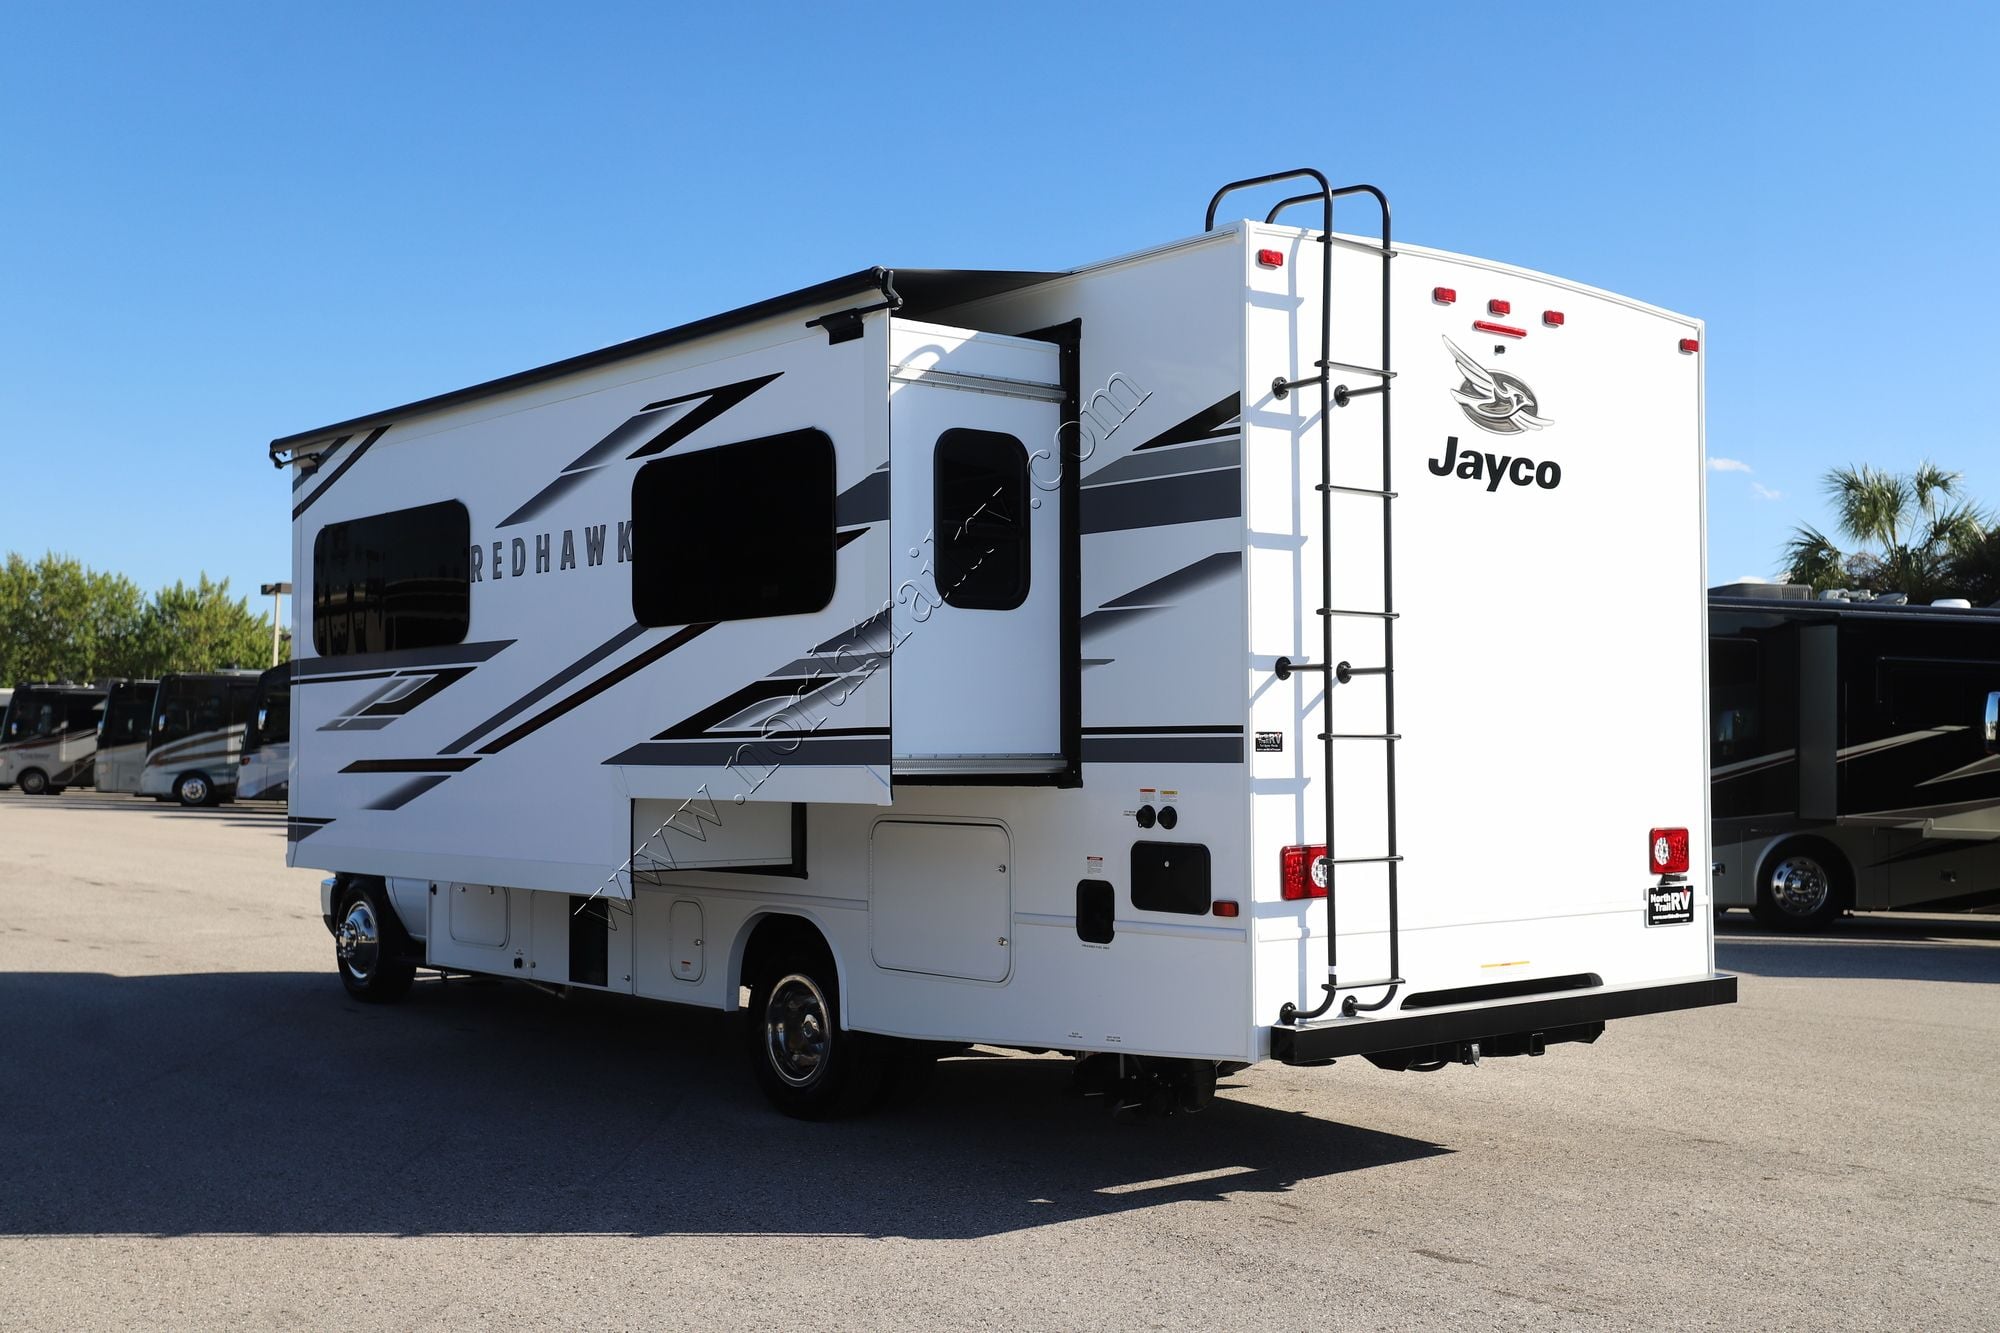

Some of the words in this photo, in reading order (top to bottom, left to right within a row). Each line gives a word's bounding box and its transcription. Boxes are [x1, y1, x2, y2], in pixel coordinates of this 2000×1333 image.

[1428, 435, 1562, 492] Jayco
[470, 520, 633, 583] REDHAWK
[1650, 893, 1671, 903] North
[1654, 902, 1671, 912] Trail
[1670, 891, 1691, 911] RV
